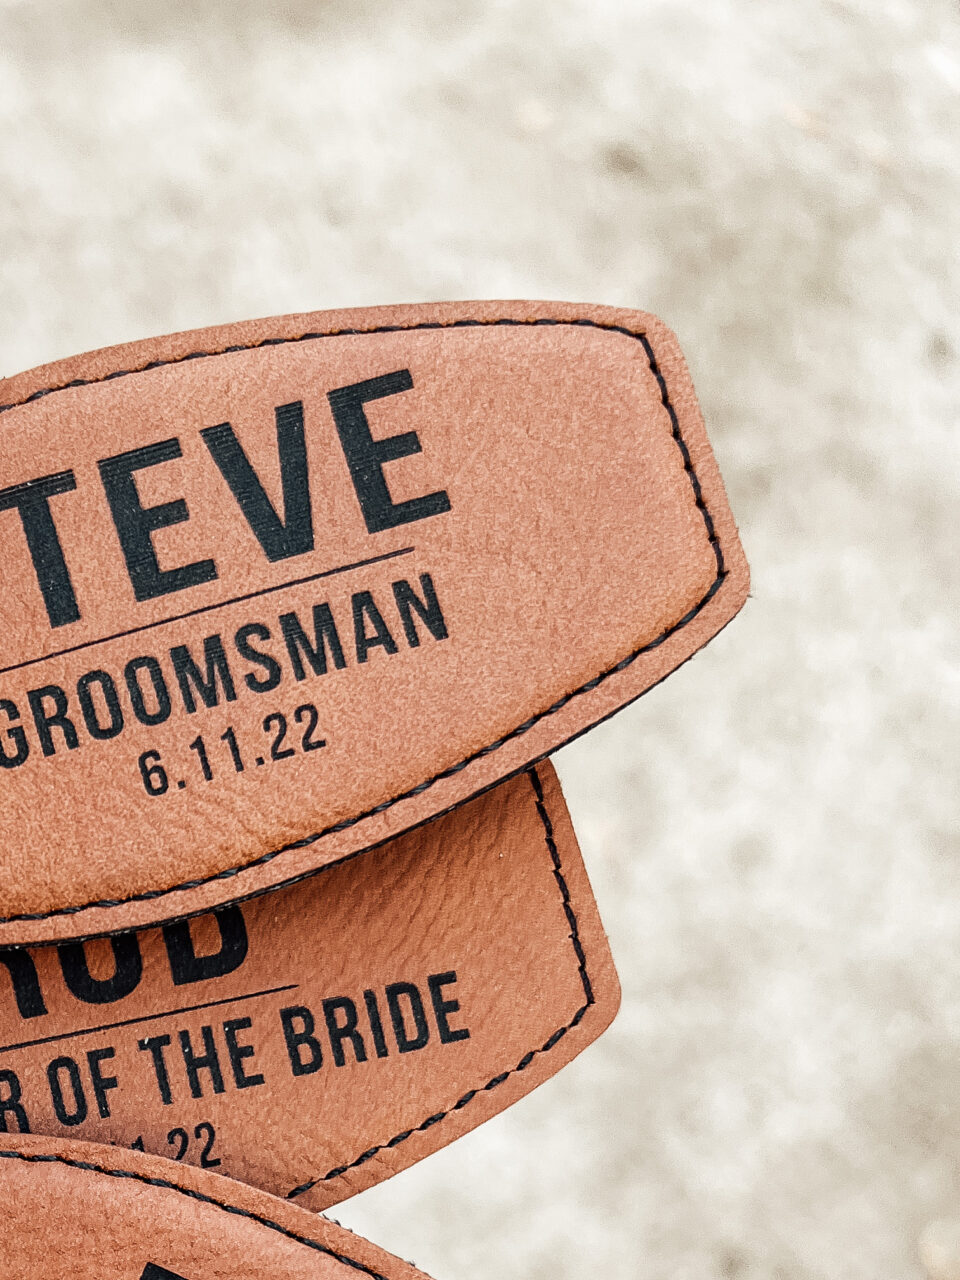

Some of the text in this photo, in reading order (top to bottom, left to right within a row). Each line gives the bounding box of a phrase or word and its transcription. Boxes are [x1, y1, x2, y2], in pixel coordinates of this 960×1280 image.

[138, 703, 327, 797] 6.11.22
[46, 1046, 118, 1127] OF
[137, 1016, 266, 1105] THE
[279, 970, 471, 1077] BRIDE
